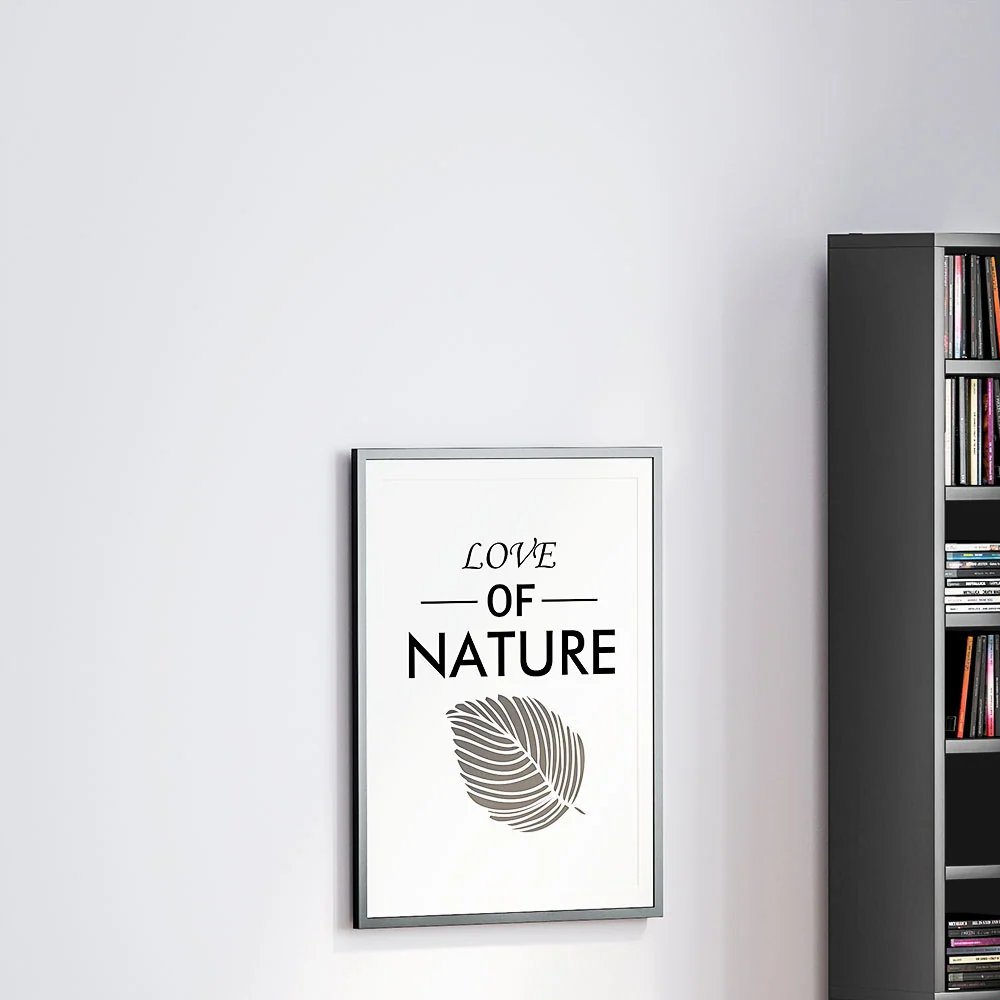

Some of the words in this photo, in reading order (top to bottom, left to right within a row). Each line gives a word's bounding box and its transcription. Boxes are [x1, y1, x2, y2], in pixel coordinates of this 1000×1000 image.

[462, 538, 557, 570] LOVE
[487, 583, 535, 618] OF
[408, 629, 616, 679] NATURE
